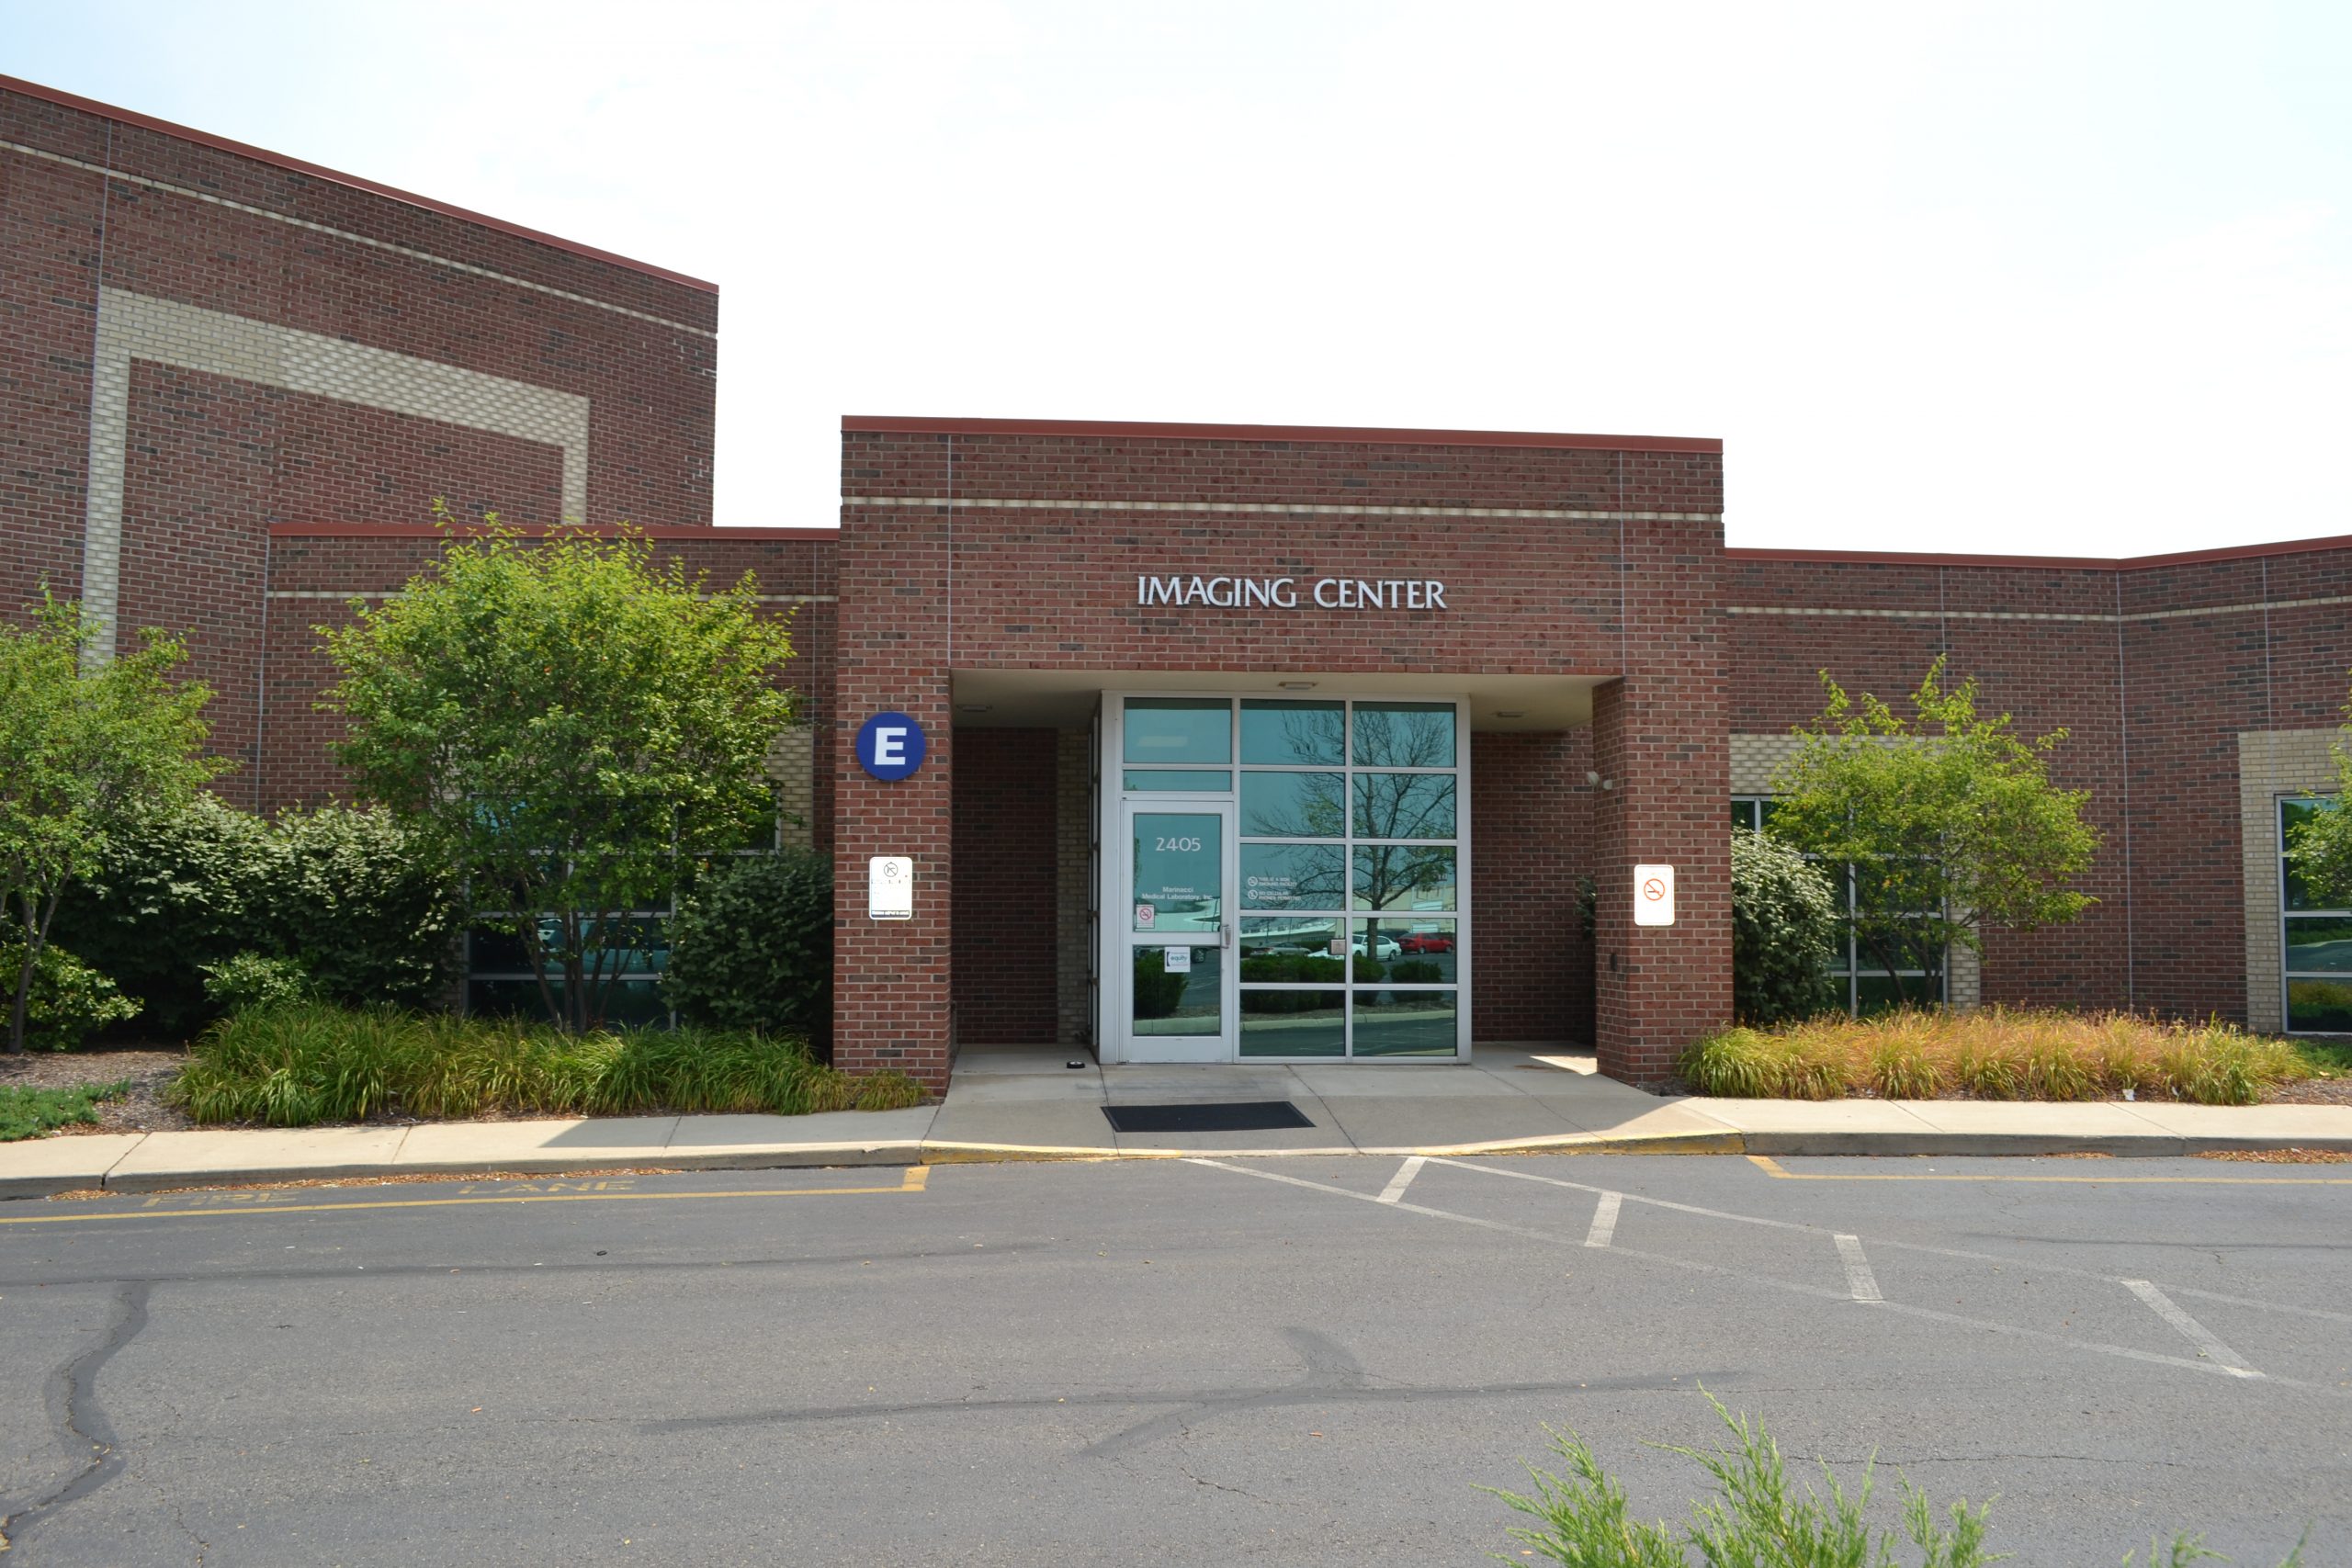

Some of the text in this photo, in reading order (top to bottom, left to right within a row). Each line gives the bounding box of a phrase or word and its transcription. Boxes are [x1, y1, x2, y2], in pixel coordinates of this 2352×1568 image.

[1137, 576, 1448, 610] IMAGING CENTER
[874, 727, 908, 765] E
[1155, 837, 1202, 852] 2405
[141, 1179, 635, 1208] FIRE LANE
